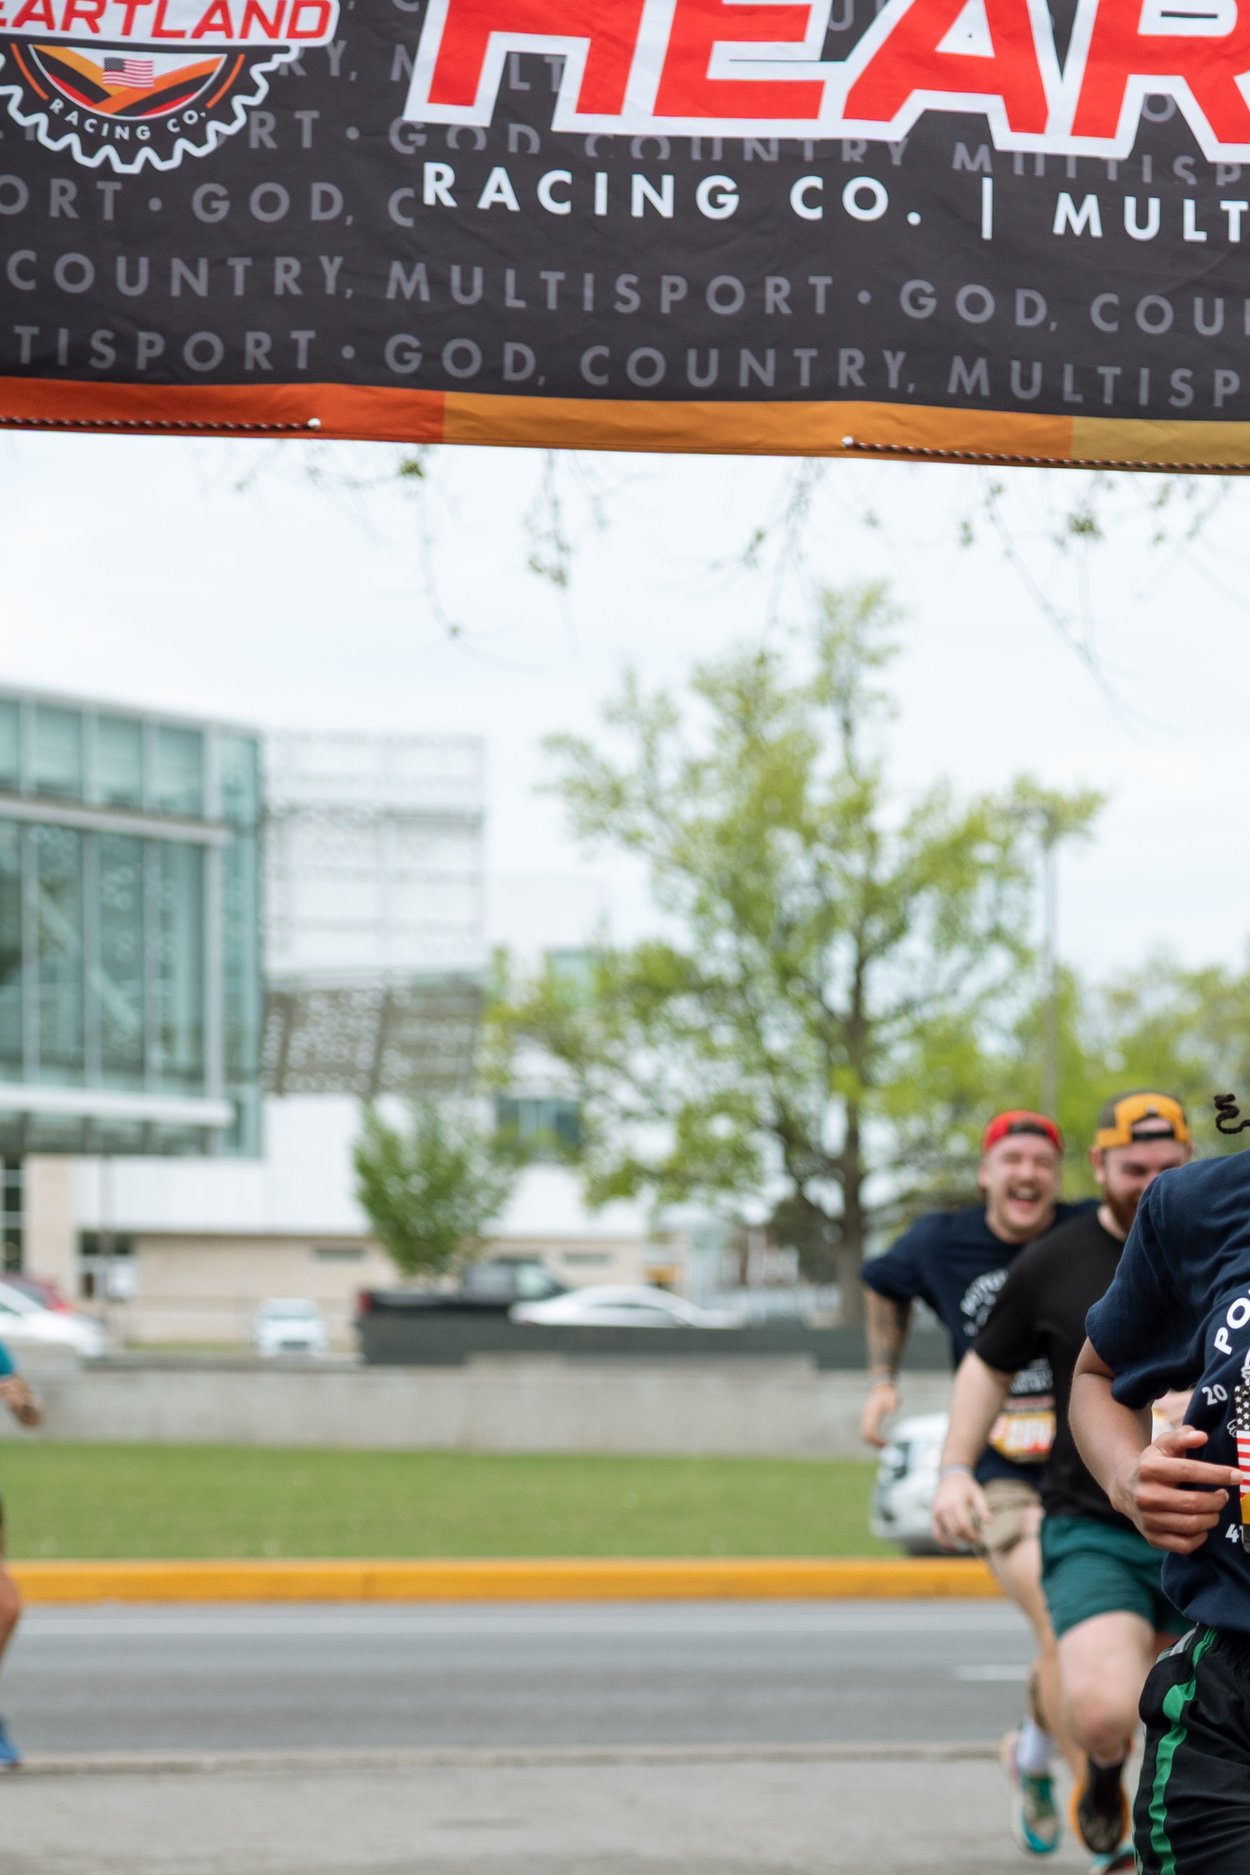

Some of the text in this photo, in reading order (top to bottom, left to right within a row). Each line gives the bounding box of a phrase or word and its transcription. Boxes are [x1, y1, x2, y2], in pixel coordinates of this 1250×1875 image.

[0, 0, 333, 41] ARTLAND
[49, 98, 151, 141] RACING
[166, 110, 206, 134] CO.
[192, 182, 353, 226] GOD,
[423, 162, 739, 221] RACING
[790, 176, 921, 226] CO.
[6, 249, 353, 299] COUNTRY,
[387, 262, 833, 316] MULTISPORT
[900, 279, 1057, 332] GOD,
[384, 334, 546, 386] GOD,
[580, 345, 916, 394] COUNTRY,
